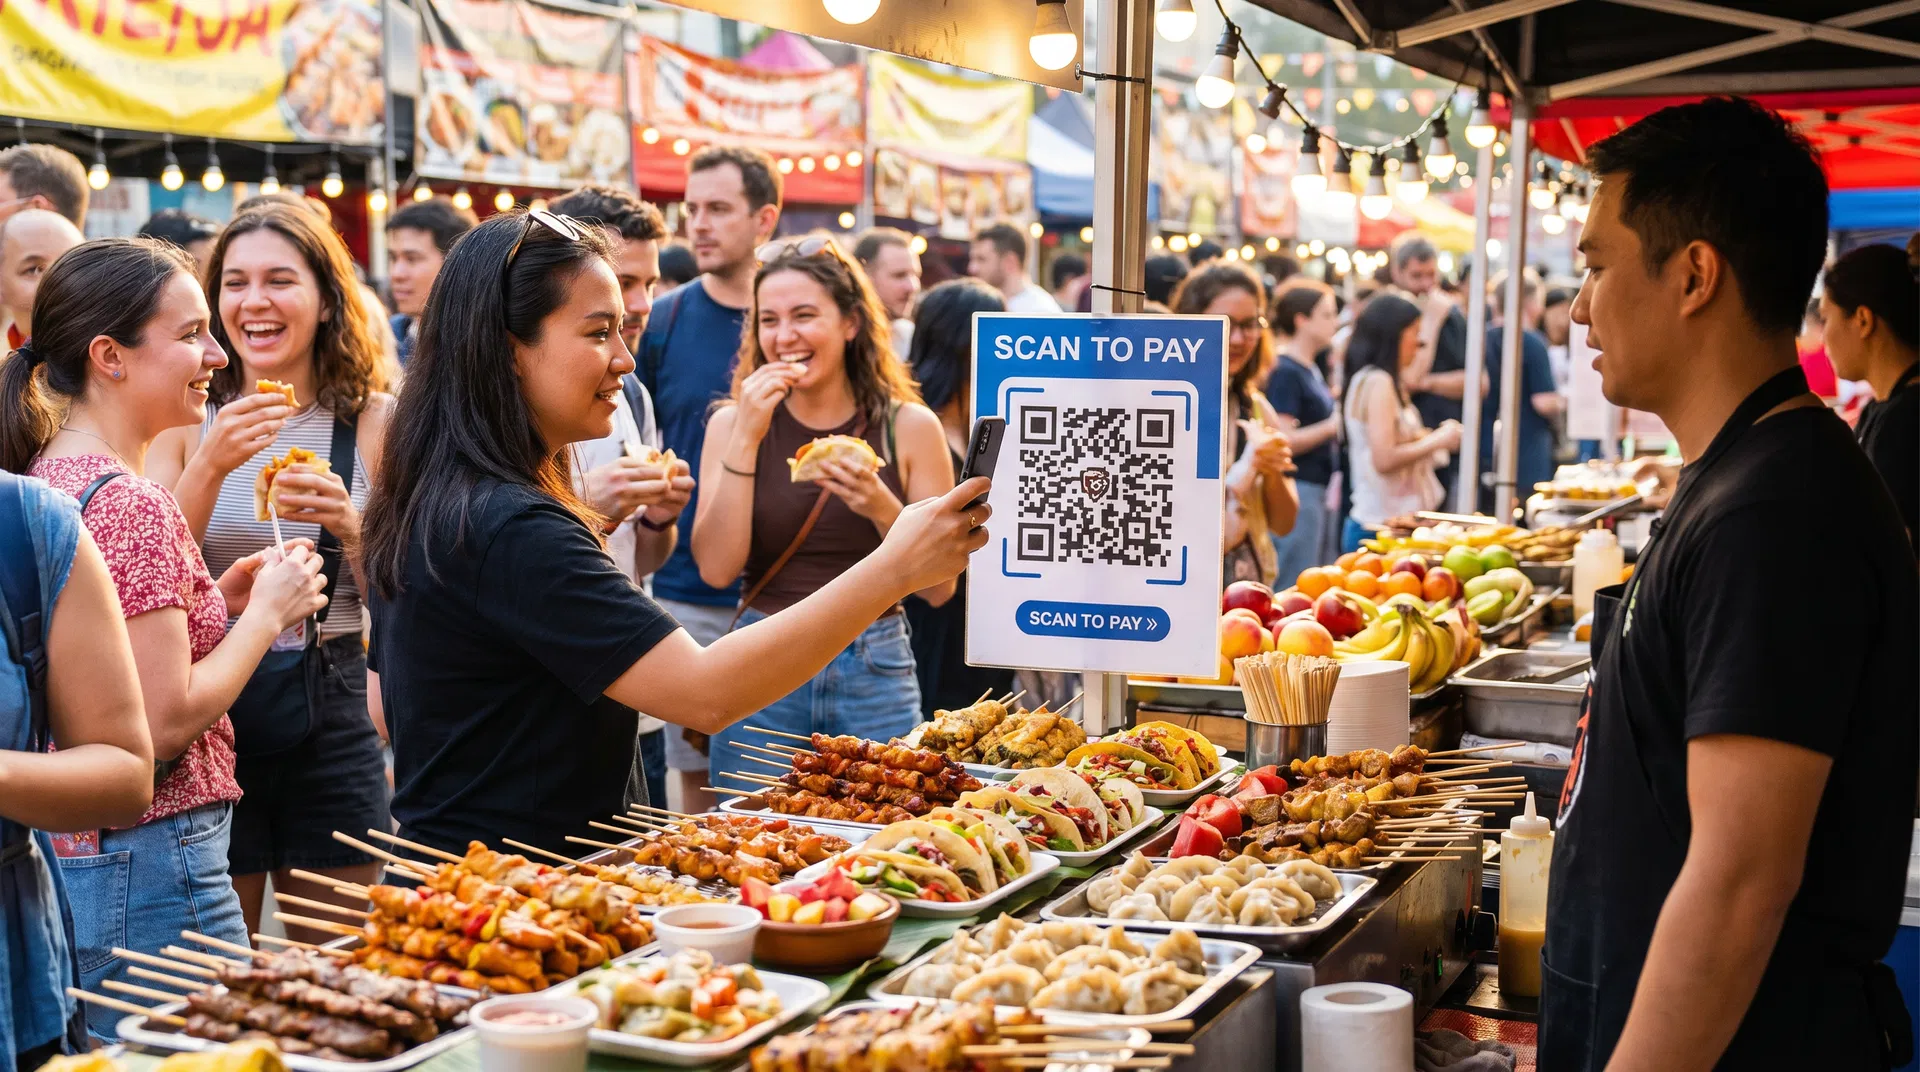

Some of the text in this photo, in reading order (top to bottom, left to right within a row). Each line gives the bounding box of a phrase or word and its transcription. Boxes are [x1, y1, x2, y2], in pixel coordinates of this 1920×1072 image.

[994, 335, 1205, 363] SCAN TO PAY
[1029, 611, 1142, 631] SCAN TO PAY
